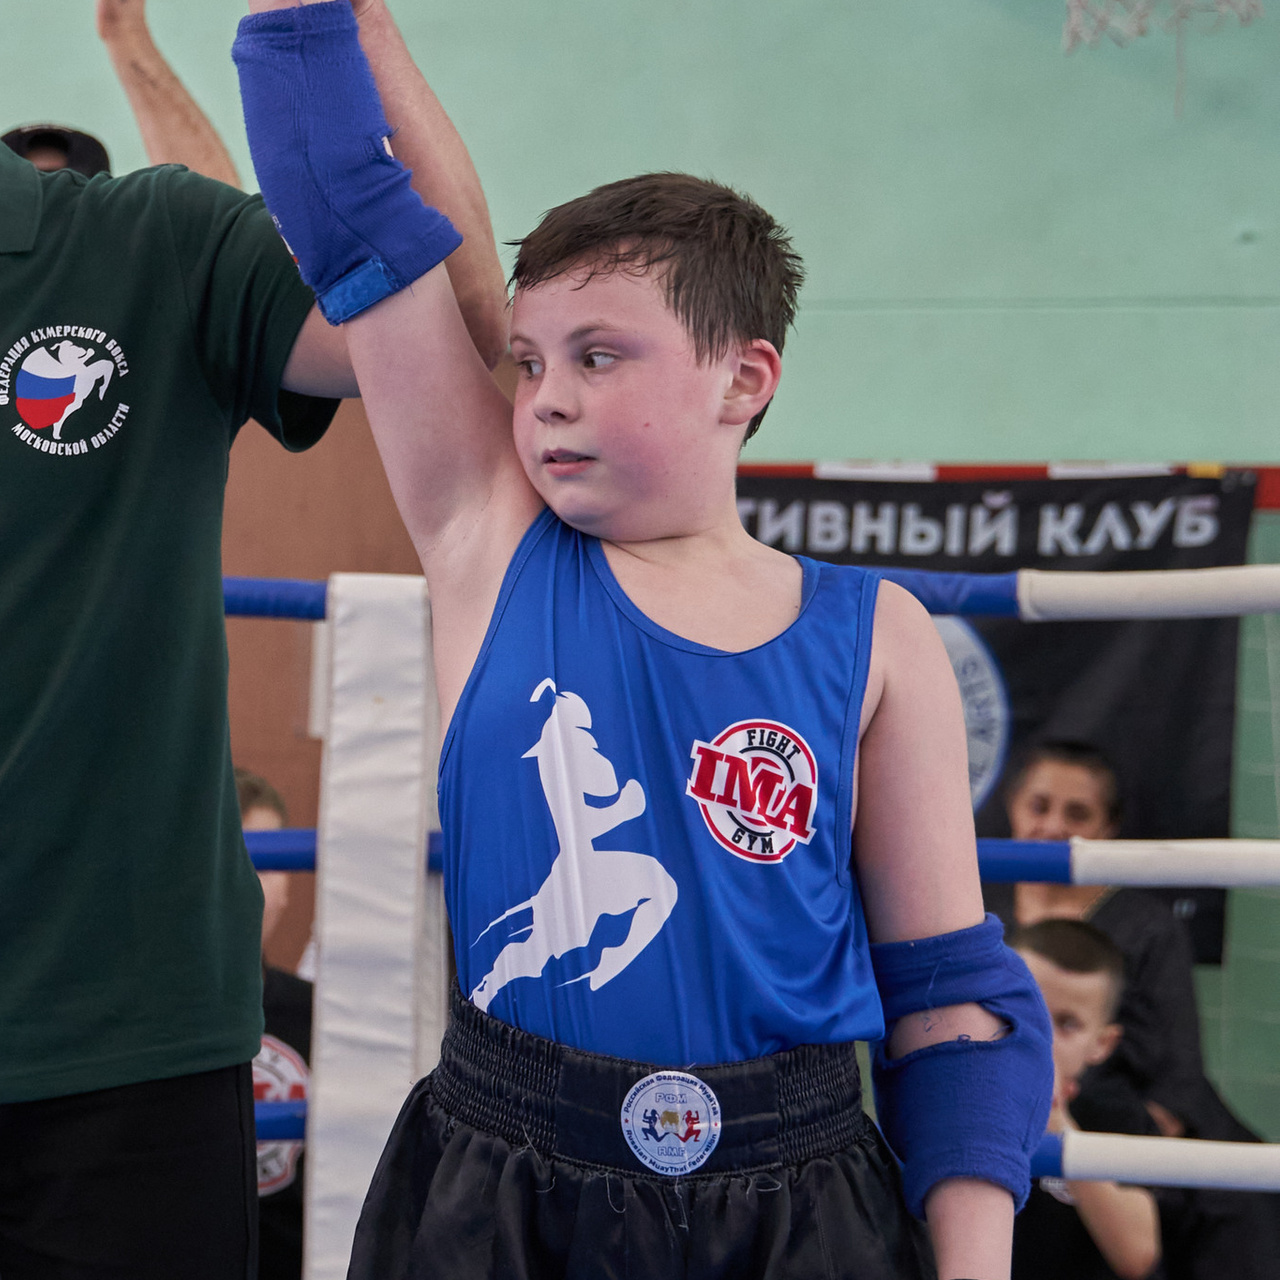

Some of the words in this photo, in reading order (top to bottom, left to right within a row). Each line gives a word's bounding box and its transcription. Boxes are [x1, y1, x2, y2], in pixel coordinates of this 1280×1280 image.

[30, 325, 107, 344] КХМЕРСКОГО
[105, 338, 129, 377] БОКСА
[11, 422, 89, 456] МОСКОВСКОЙ
[90, 402, 130, 449] ОБЛАСТИ
[1037, 494, 1218, 556] КЛУБ
[747, 728, 801, 761] FIGHT
[690, 745, 813, 839] IMA
[731, 827, 774, 854] GYM
[655, 1092, 688, 1104] РФМ
[625, 1129, 649, 1161] Russian
